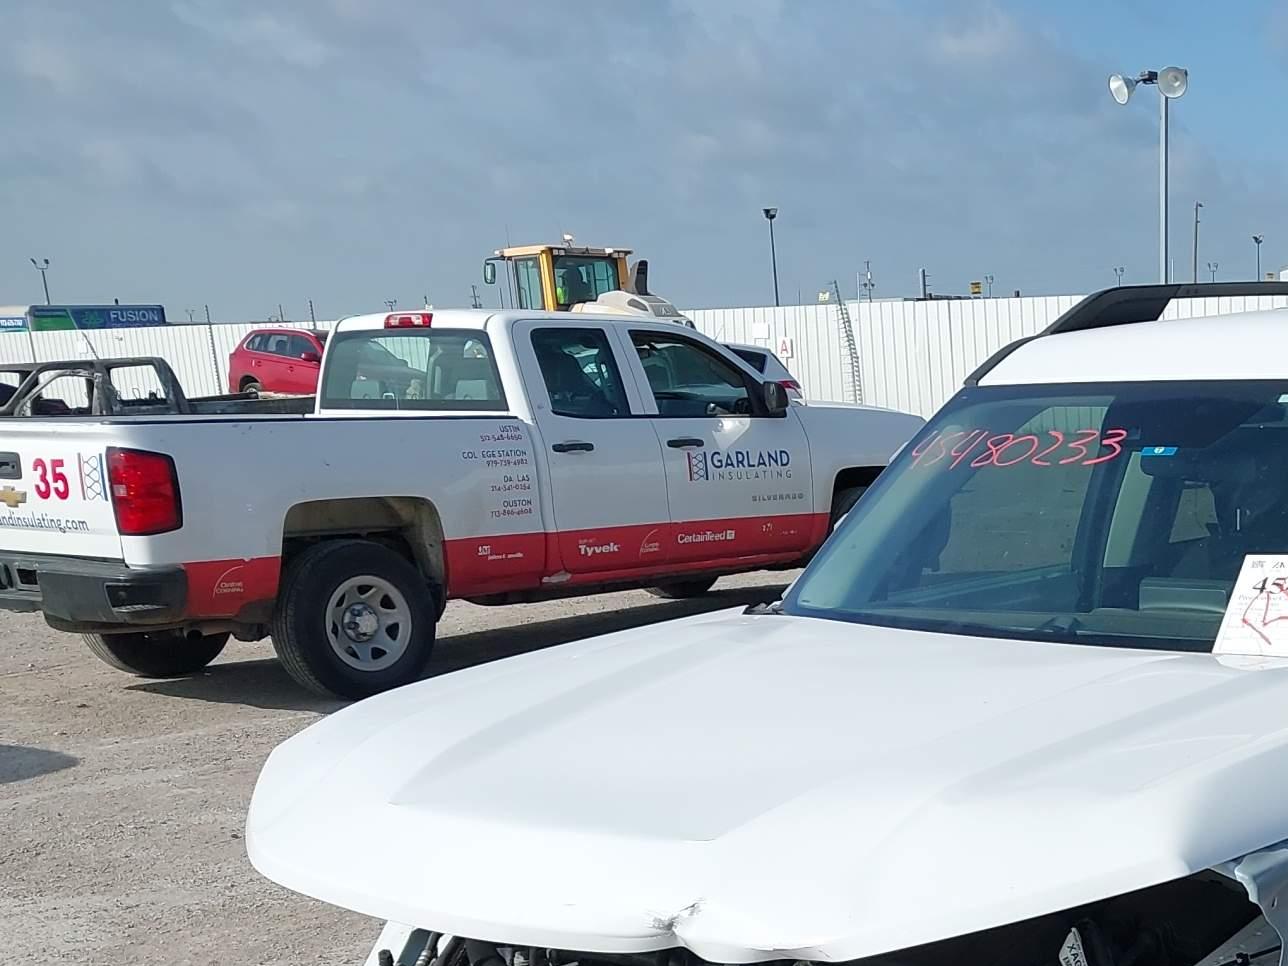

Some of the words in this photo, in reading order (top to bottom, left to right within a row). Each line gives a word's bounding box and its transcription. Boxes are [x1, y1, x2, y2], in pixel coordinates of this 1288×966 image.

[109, 310, 159, 323] FUSION
[780, 339, 789, 355] A
[909, 429, 1128, 471] 45480233
[710, 450, 790, 469] GARLAND
[32, 458, 69, 500] 35
[711, 469, 792, 481] INSULATING
[677, 530, 726, 544] CertainTeed
[578, 542, 621, 557] Tyvek
